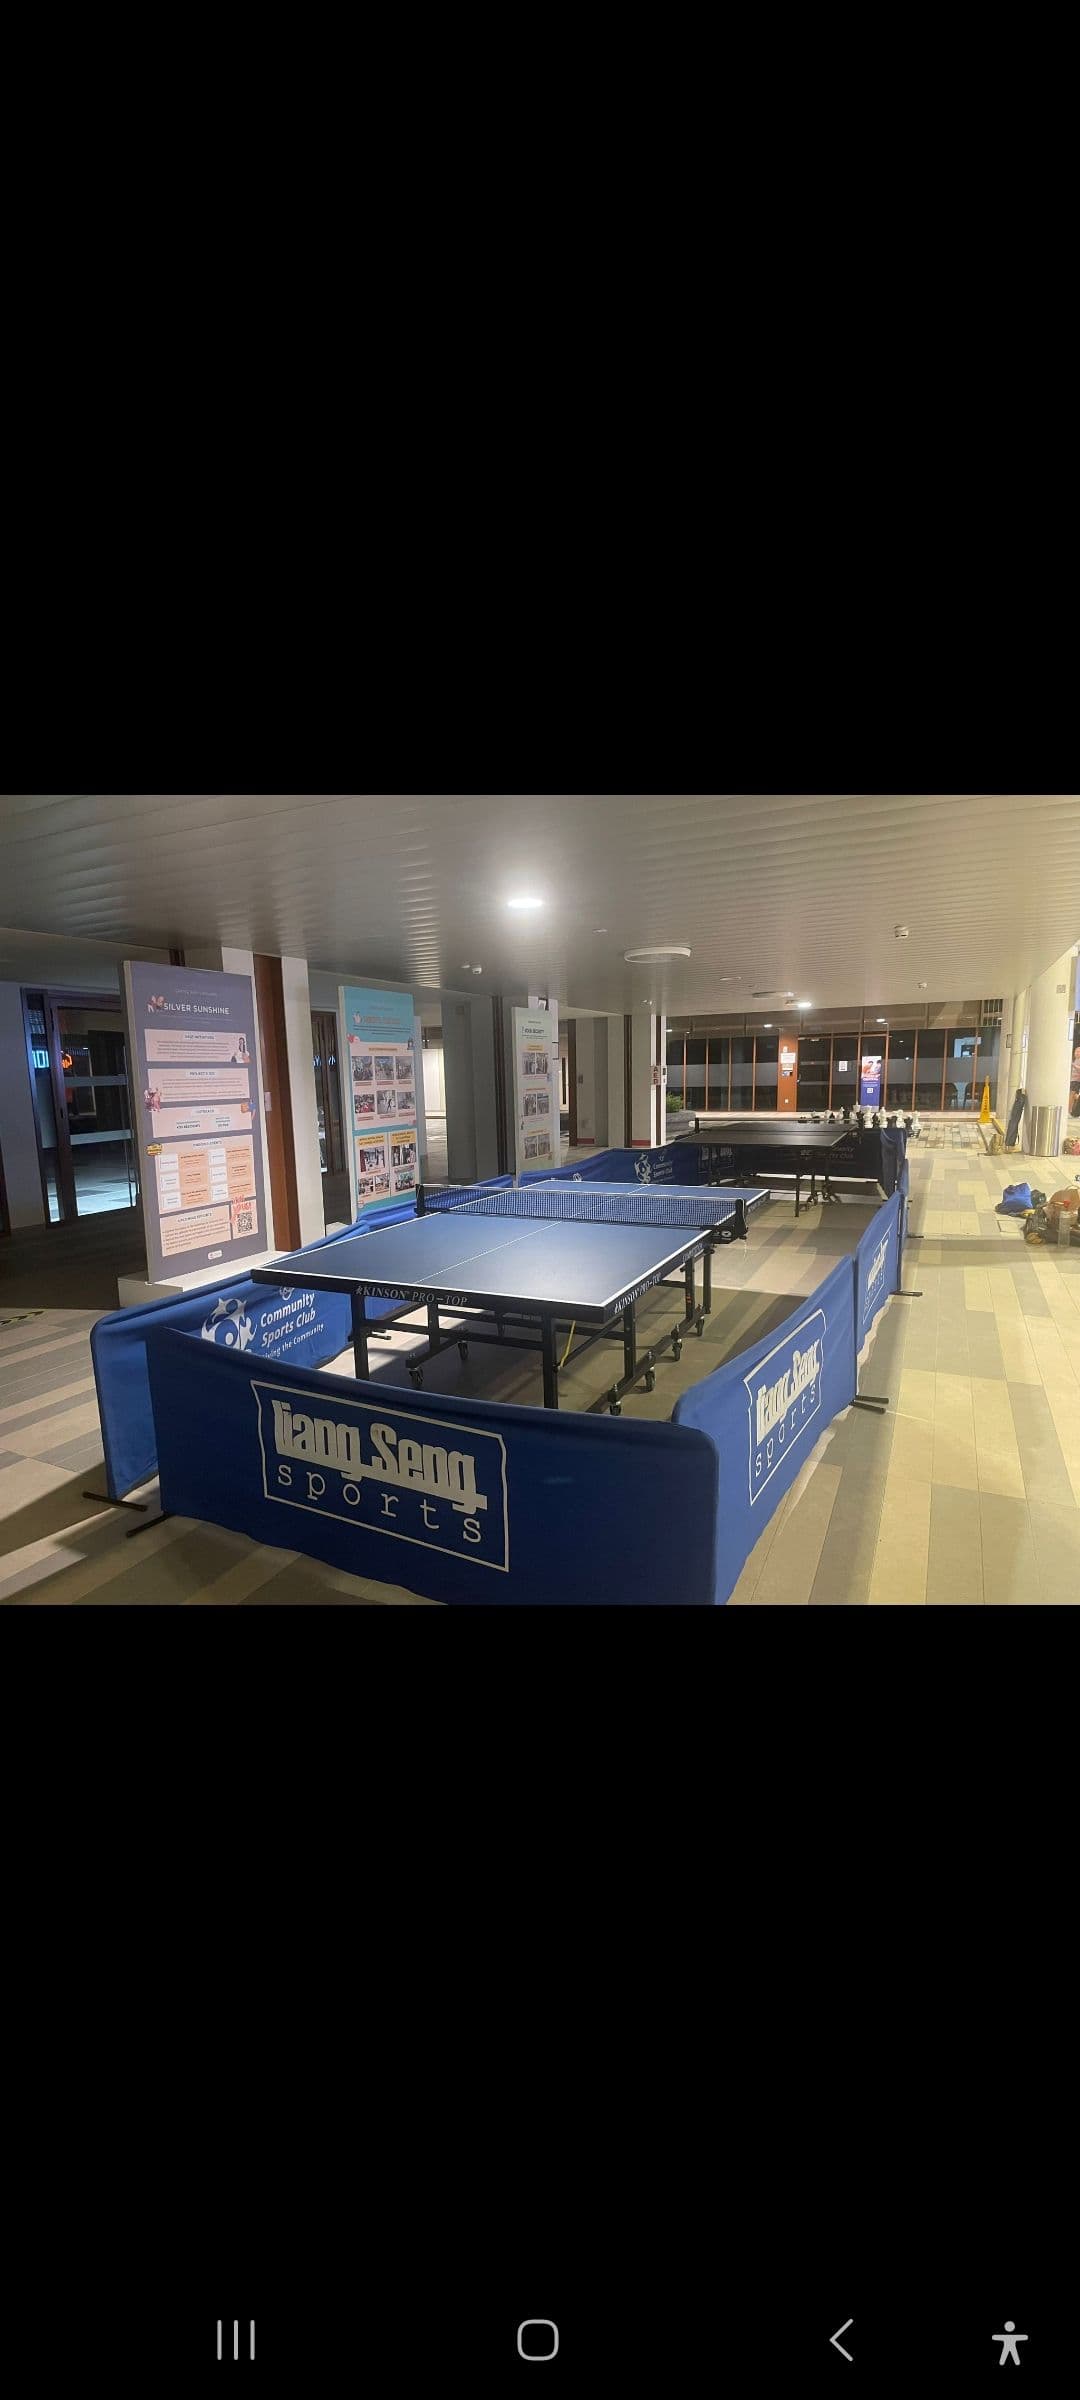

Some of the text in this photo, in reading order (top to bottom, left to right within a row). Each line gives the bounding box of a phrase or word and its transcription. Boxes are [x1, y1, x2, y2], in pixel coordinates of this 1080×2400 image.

[164, 1003, 230, 1015] SILVER SUNSHINE
[260, 1293, 315, 1328] Community
[261, 1307, 316, 1348] Sports Club
[293, 1323, 324, 1345] Community
[755, 1380, 816, 1478] sports
[277, 1464, 482, 1543] sports
